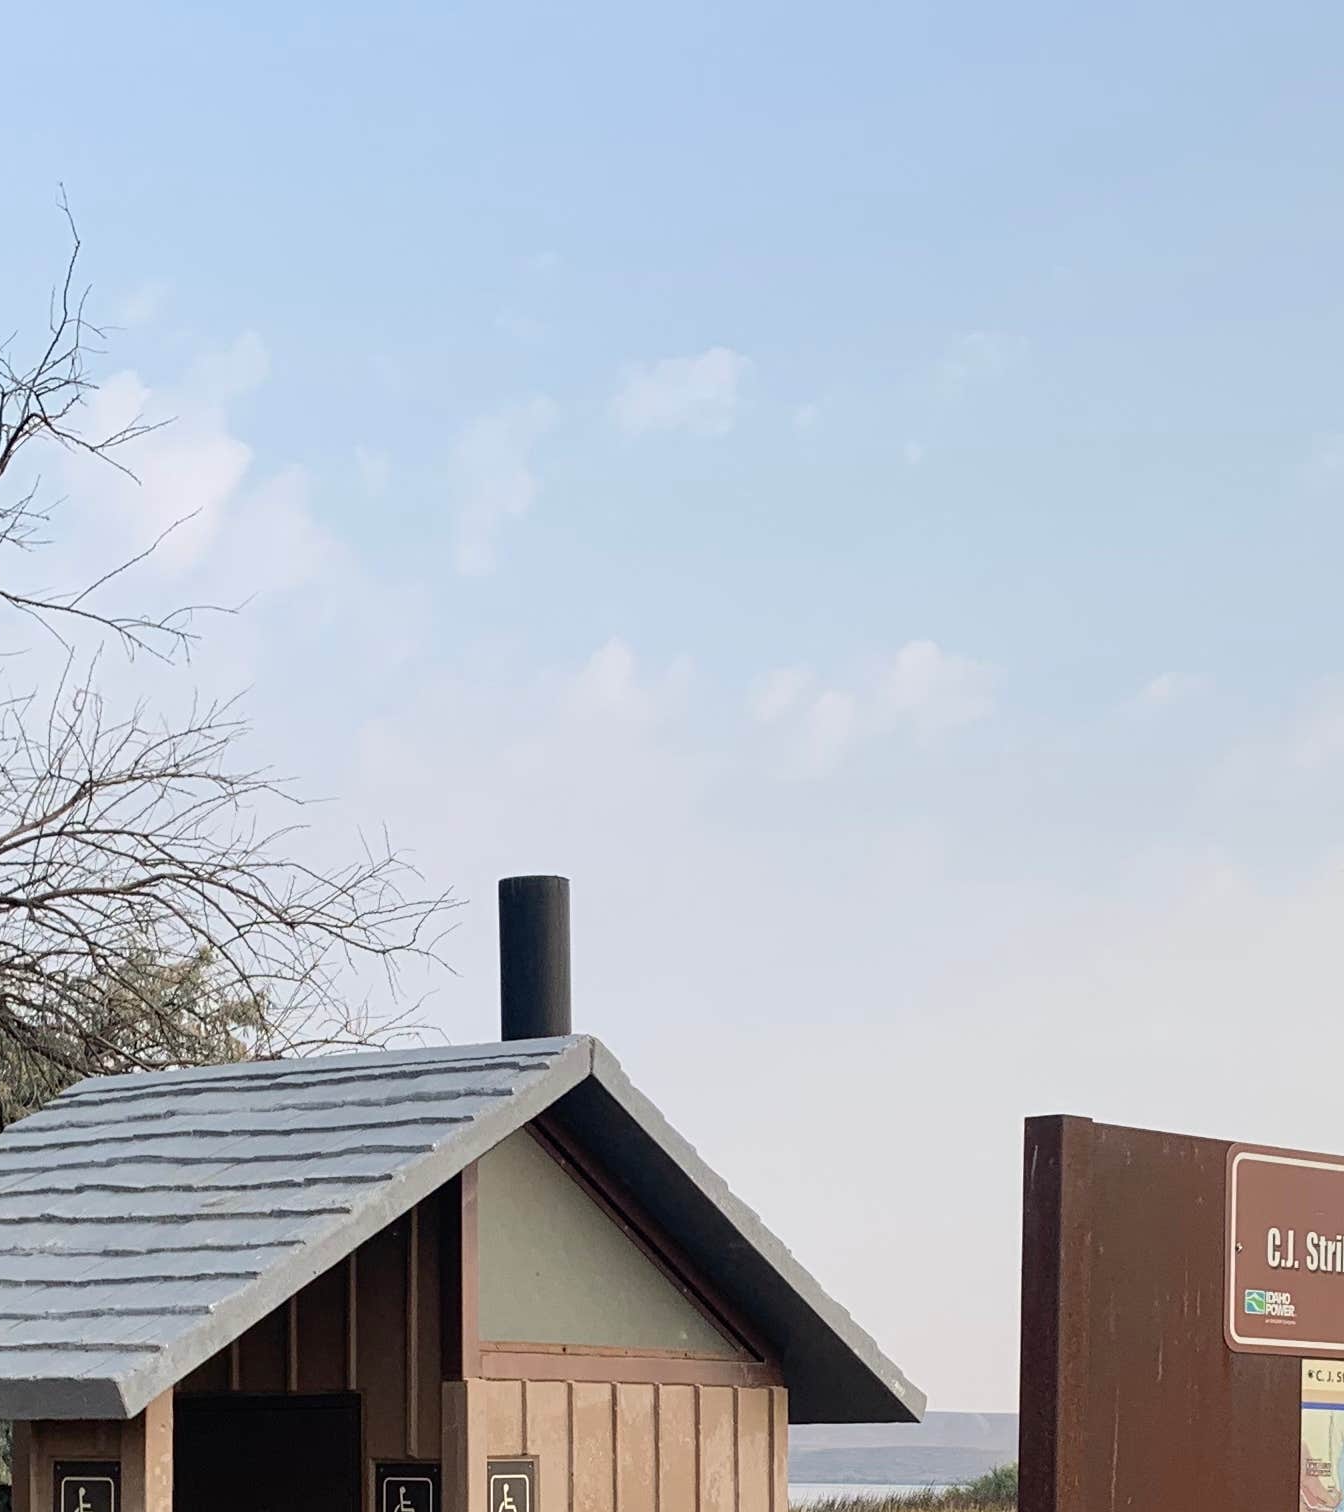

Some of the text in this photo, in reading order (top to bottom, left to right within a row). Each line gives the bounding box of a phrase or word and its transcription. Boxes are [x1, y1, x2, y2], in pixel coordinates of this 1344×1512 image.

[1267, 1227, 1300, 1270] C.J.
[1265, 1291, 1291, 1305] IDAHO
[1265, 1304, 1296, 1317] POWER
[1316, 1370, 1325, 1382] C.
[1327, 1371, 1334, 1383] J.
